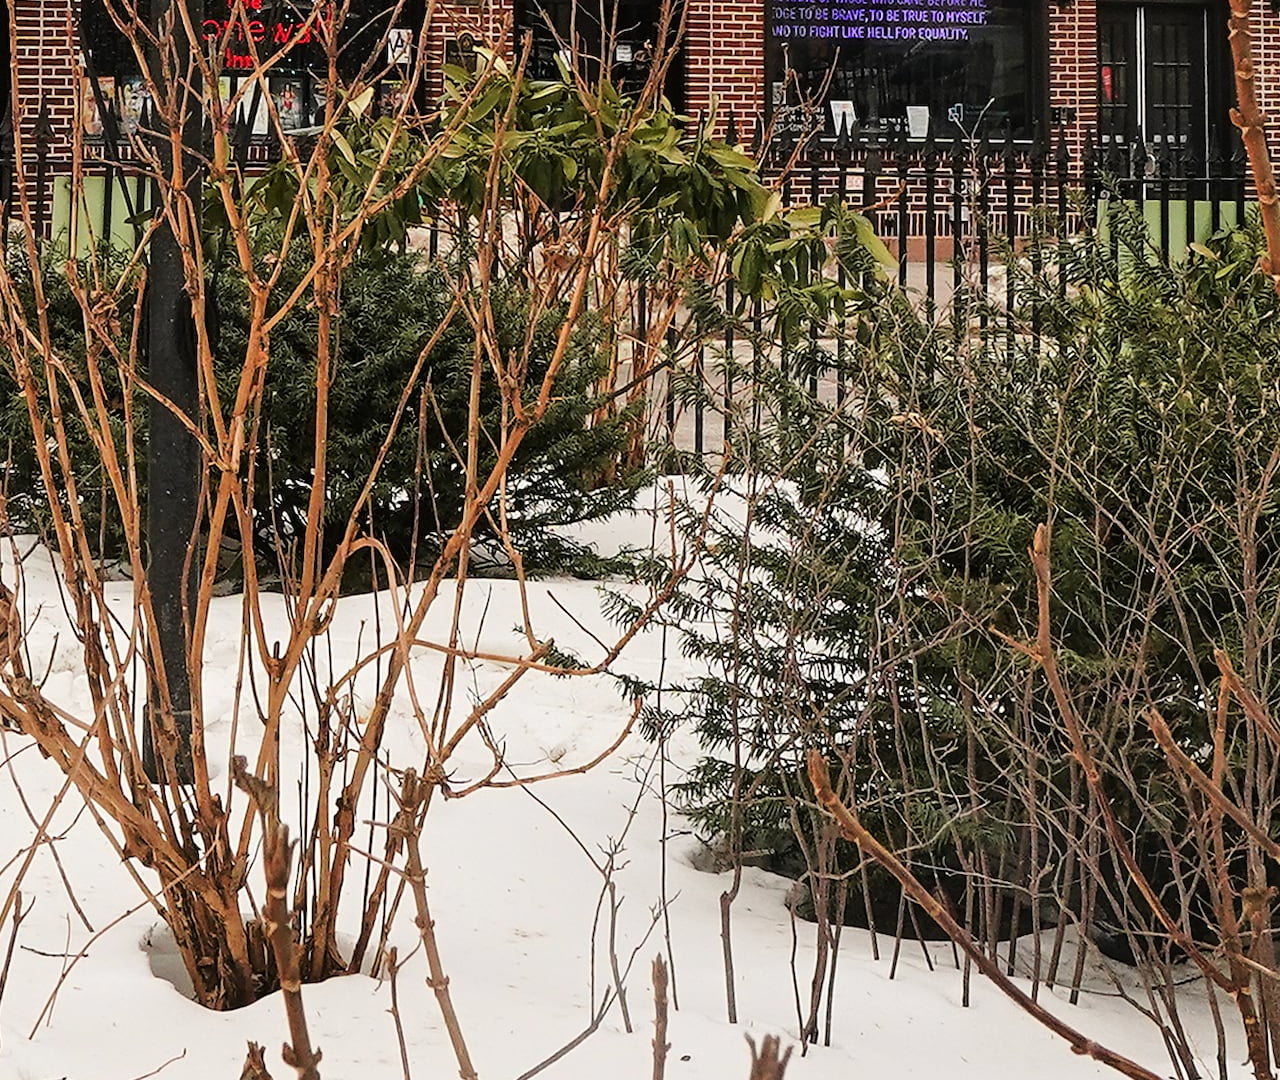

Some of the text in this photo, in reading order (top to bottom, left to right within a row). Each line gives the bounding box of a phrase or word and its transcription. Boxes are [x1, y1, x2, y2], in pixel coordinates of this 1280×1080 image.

[798, 7, 813, 20] TO
[815, 7, 829, 21] BE
[831, 8, 868, 24] BRAVE,
[869, 9, 884, 22] TO
[886, 10, 900, 22] BE
[902, 10, 929, 22] TRUE
[931, 11, 944, 23] TO
[792, 25, 807, 38] TO
[809, 25, 840, 38] FIGHT
[841, 26, 865, 39] LIKE
[867, 26, 894, 39] HELL
[895, 27, 916, 40] FOR
[225, 48, 254, 69] Inn
